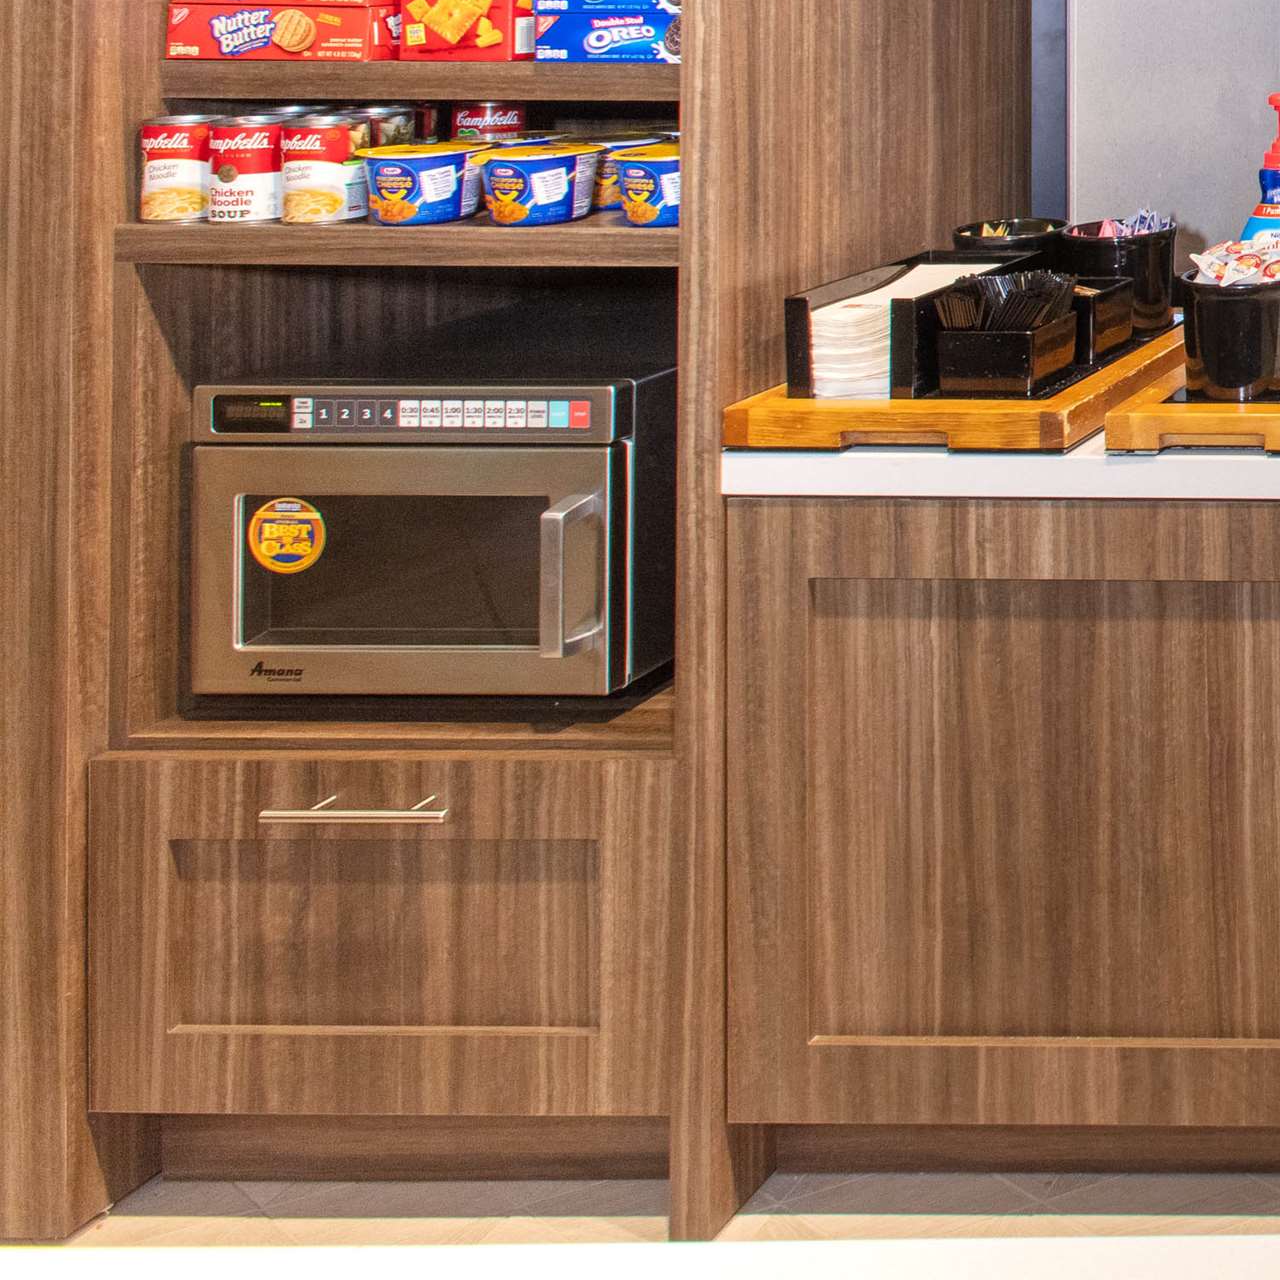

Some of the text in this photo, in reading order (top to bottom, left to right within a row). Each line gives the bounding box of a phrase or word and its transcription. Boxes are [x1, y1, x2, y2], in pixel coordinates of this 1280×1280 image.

[212, 10, 271, 37] Nutter
[219, 23, 275, 53] Butter
[583, 24, 656, 52] OREO
[210, 188, 254, 198] Chicken
[210, 197, 252, 208] Noodle
[210, 209, 250, 219] SOUP
[320, 408, 328, 419] 1
[342, 408, 349, 419] 2
[362, 408, 370, 419] 3
[384, 408, 392, 419] 4
[261, 523, 312, 538] BEST
[260, 541, 312, 556] CLASS
[250, 660, 304, 677] Amana
